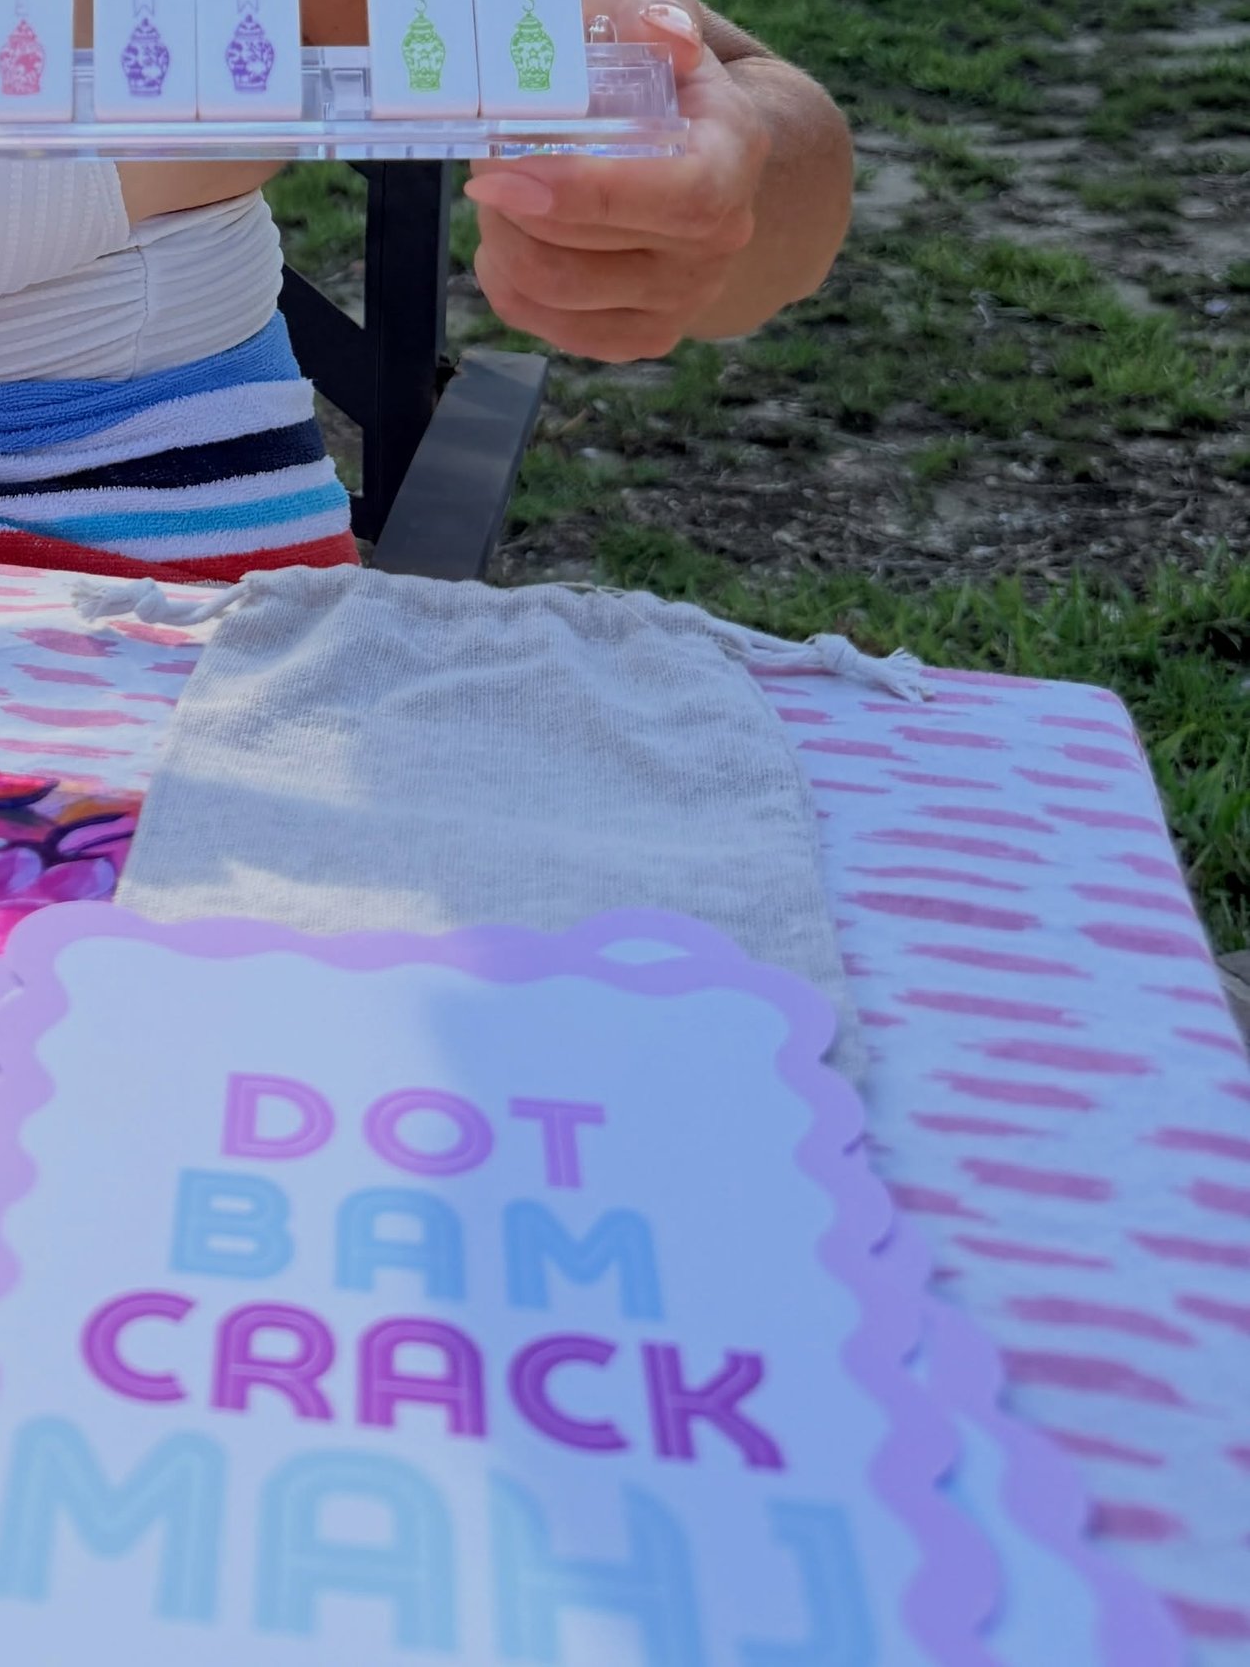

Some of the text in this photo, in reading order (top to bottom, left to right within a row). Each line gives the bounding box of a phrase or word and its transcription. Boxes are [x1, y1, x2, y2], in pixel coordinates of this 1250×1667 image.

[220, 1072, 607, 1191] DOT
[166, 1166, 666, 1323] BAM
[79, 1289, 787, 1474] CRACK
